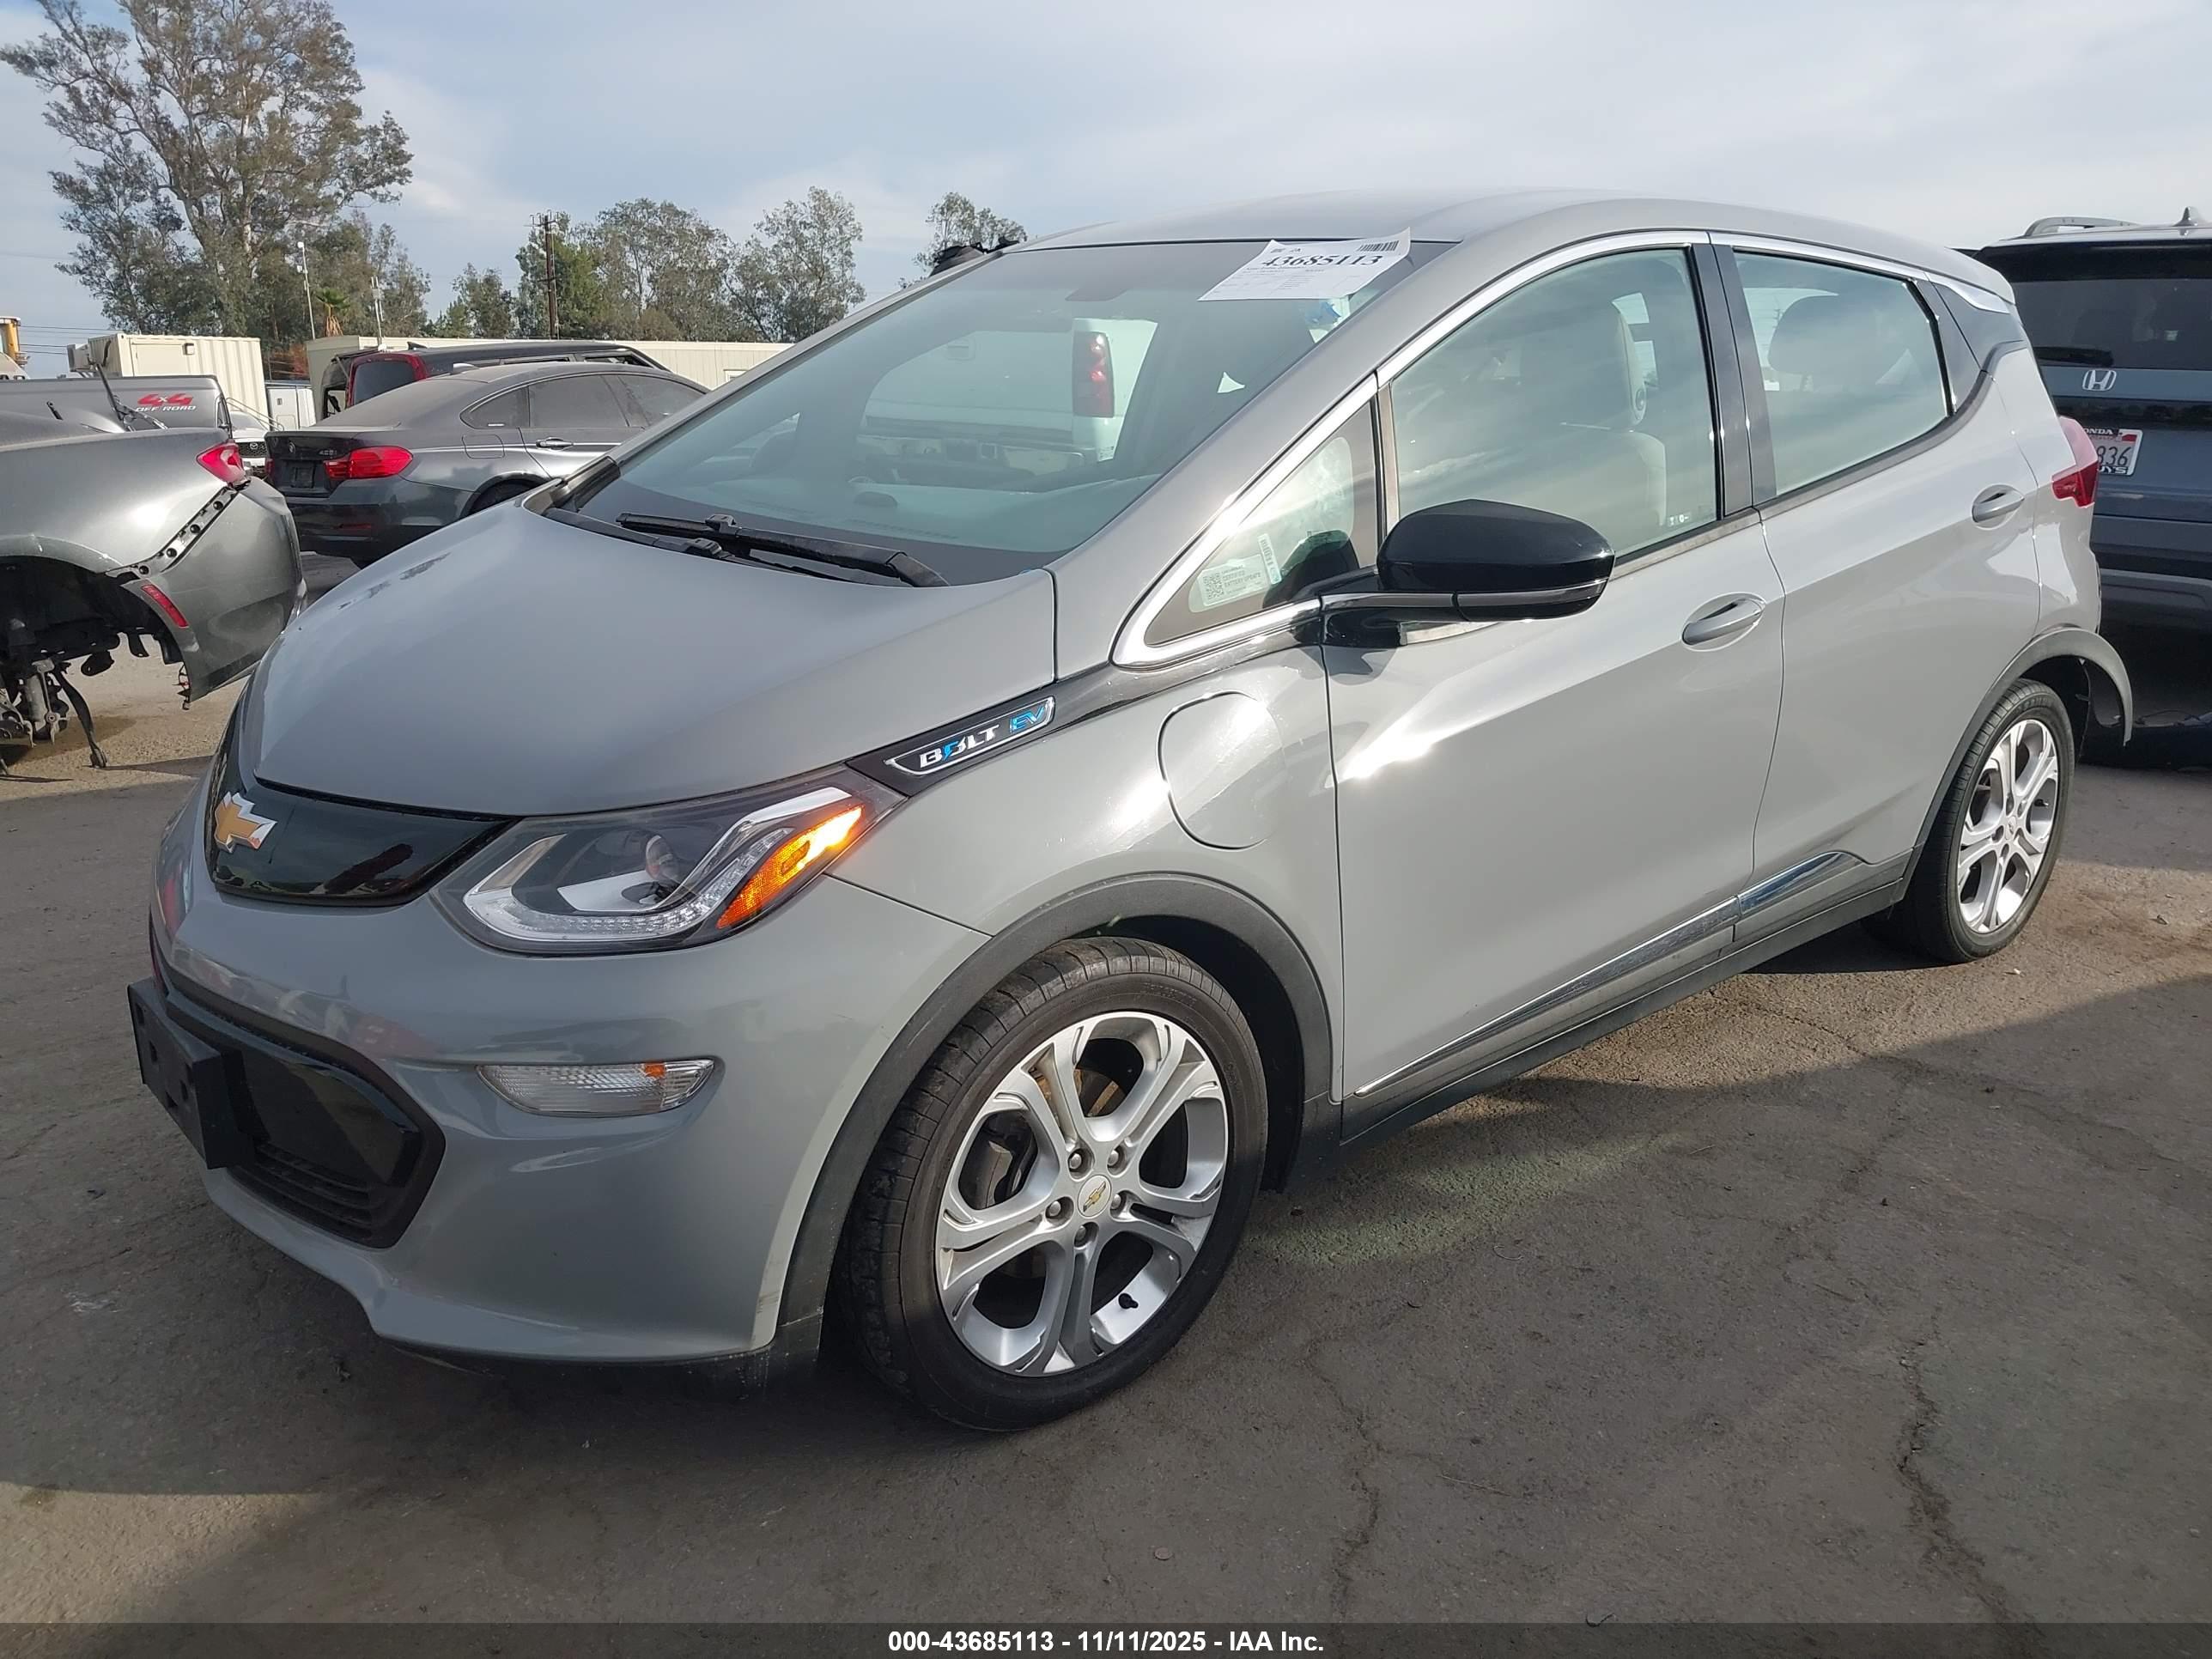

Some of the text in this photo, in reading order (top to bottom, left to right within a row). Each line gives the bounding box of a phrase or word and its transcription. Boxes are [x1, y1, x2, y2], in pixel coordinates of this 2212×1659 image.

[1261, 254, 1382, 267] 43685113
[2097, 446, 2132, 466] 836
[920, 706, 1044, 769] BOLT EV
